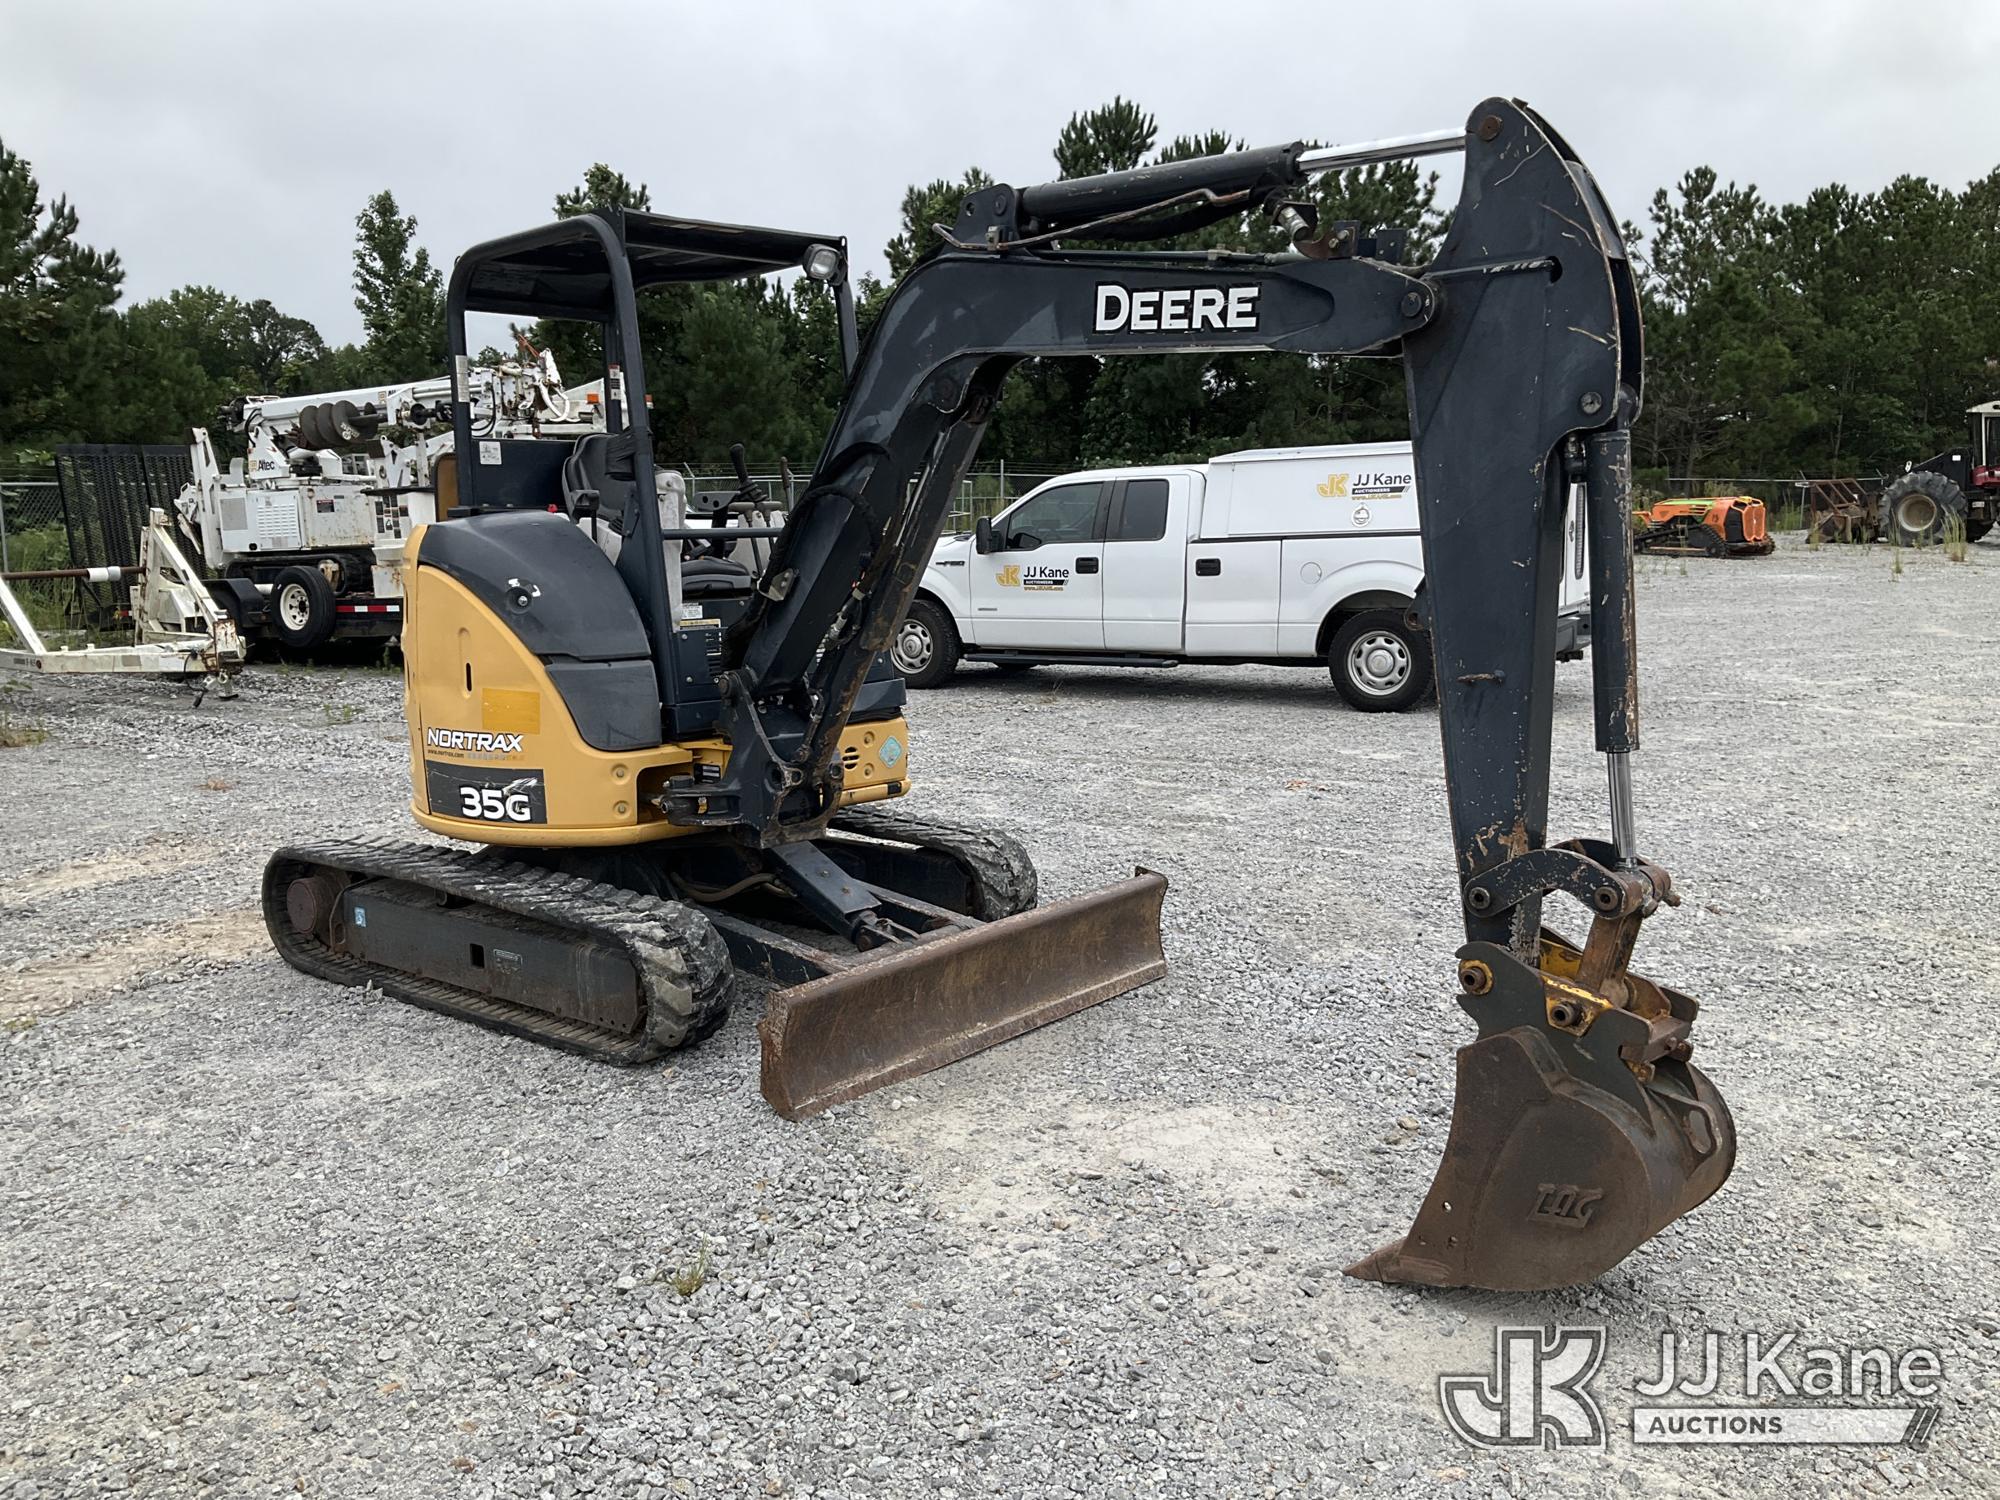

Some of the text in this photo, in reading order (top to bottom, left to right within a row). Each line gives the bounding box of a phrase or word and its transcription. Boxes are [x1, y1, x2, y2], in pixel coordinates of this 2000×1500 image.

[1095, 284, 1259, 331] DEERE
[258, 459, 275, 471] Altec
[1353, 473, 1412, 486] JJ Kane
[1024, 566, 1069, 578] JJ Kane
[427, 727, 524, 753] NORTRAX
[459, 785, 532, 823] 35G
